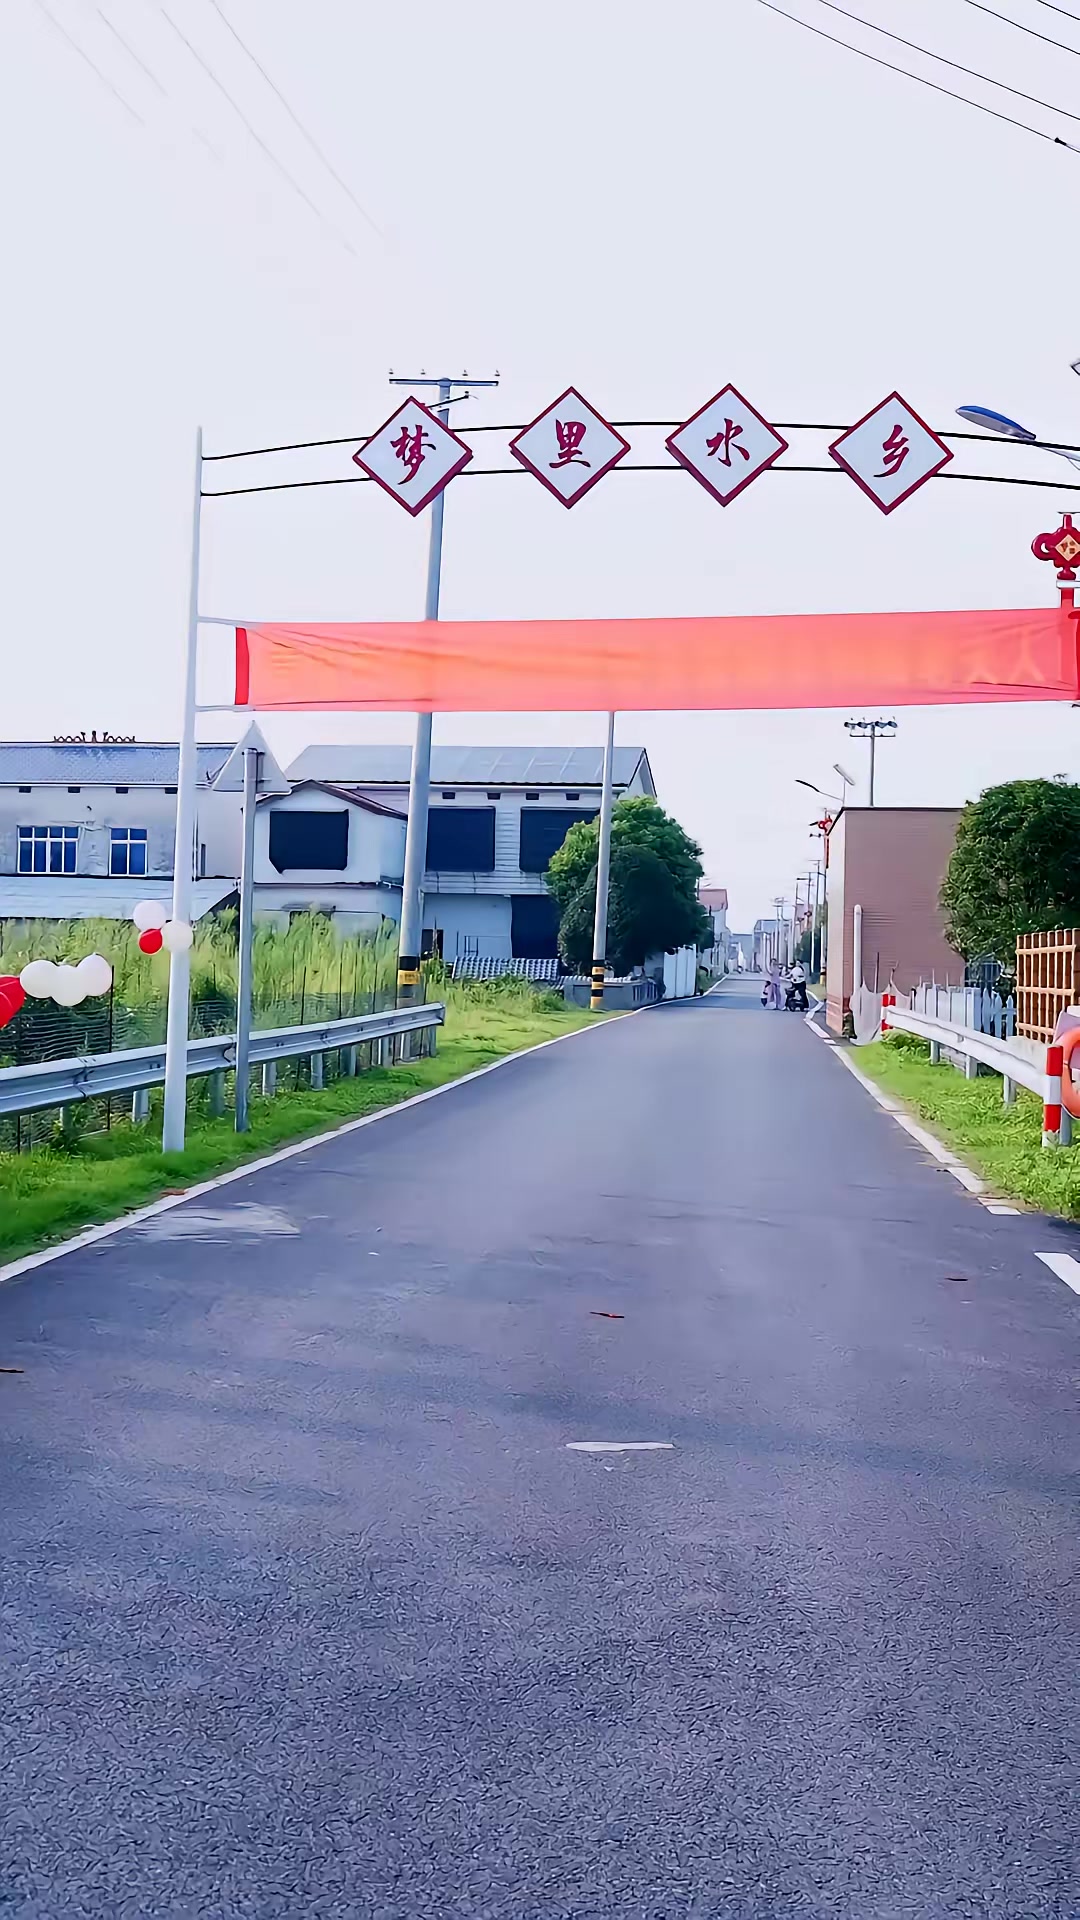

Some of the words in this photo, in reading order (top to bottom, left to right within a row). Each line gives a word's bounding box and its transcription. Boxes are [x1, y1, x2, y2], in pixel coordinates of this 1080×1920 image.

[390, 424, 437, 485] 梦
[548, 419, 592, 469] 里
[706, 418, 751, 467] 水
[873, 424, 910, 478] 乡
